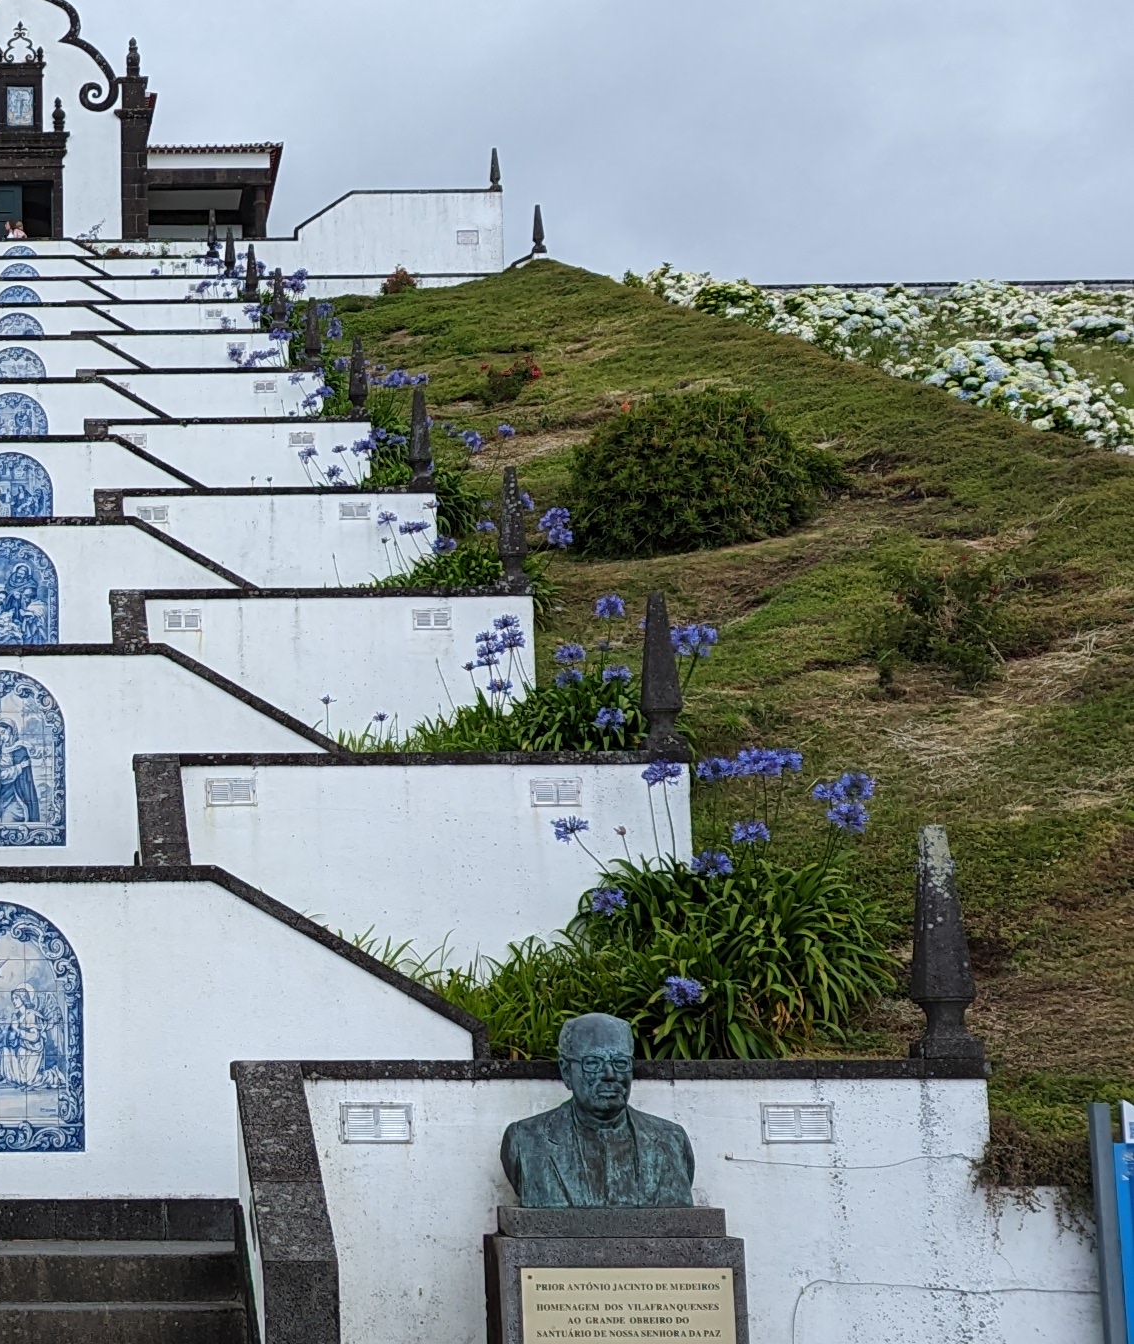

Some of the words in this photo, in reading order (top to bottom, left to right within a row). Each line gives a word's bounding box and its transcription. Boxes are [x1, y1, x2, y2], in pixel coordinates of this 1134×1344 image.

[536, 1283, 565, 1291] PRIOR
[567, 1281, 611, 1291] ANTÓNIO
[612, 1282, 654, 1292] JACINTO
[655, 1283, 668, 1291] DE
[670, 1282, 720, 1291] MEDEIROS
[536, 1303, 600, 1312] HOMENAGEM
[604, 1303, 624, 1312] DOS
[627, 1303, 720, 1312] VILAFRANQUENSES
[536, 1328, 592, 1338] SANTUÁRIO
[640, 1330, 687, 1338] SENHORA
[689, 1330, 702, 1338] DA
[703, 1330, 721, 1338] PAZ
